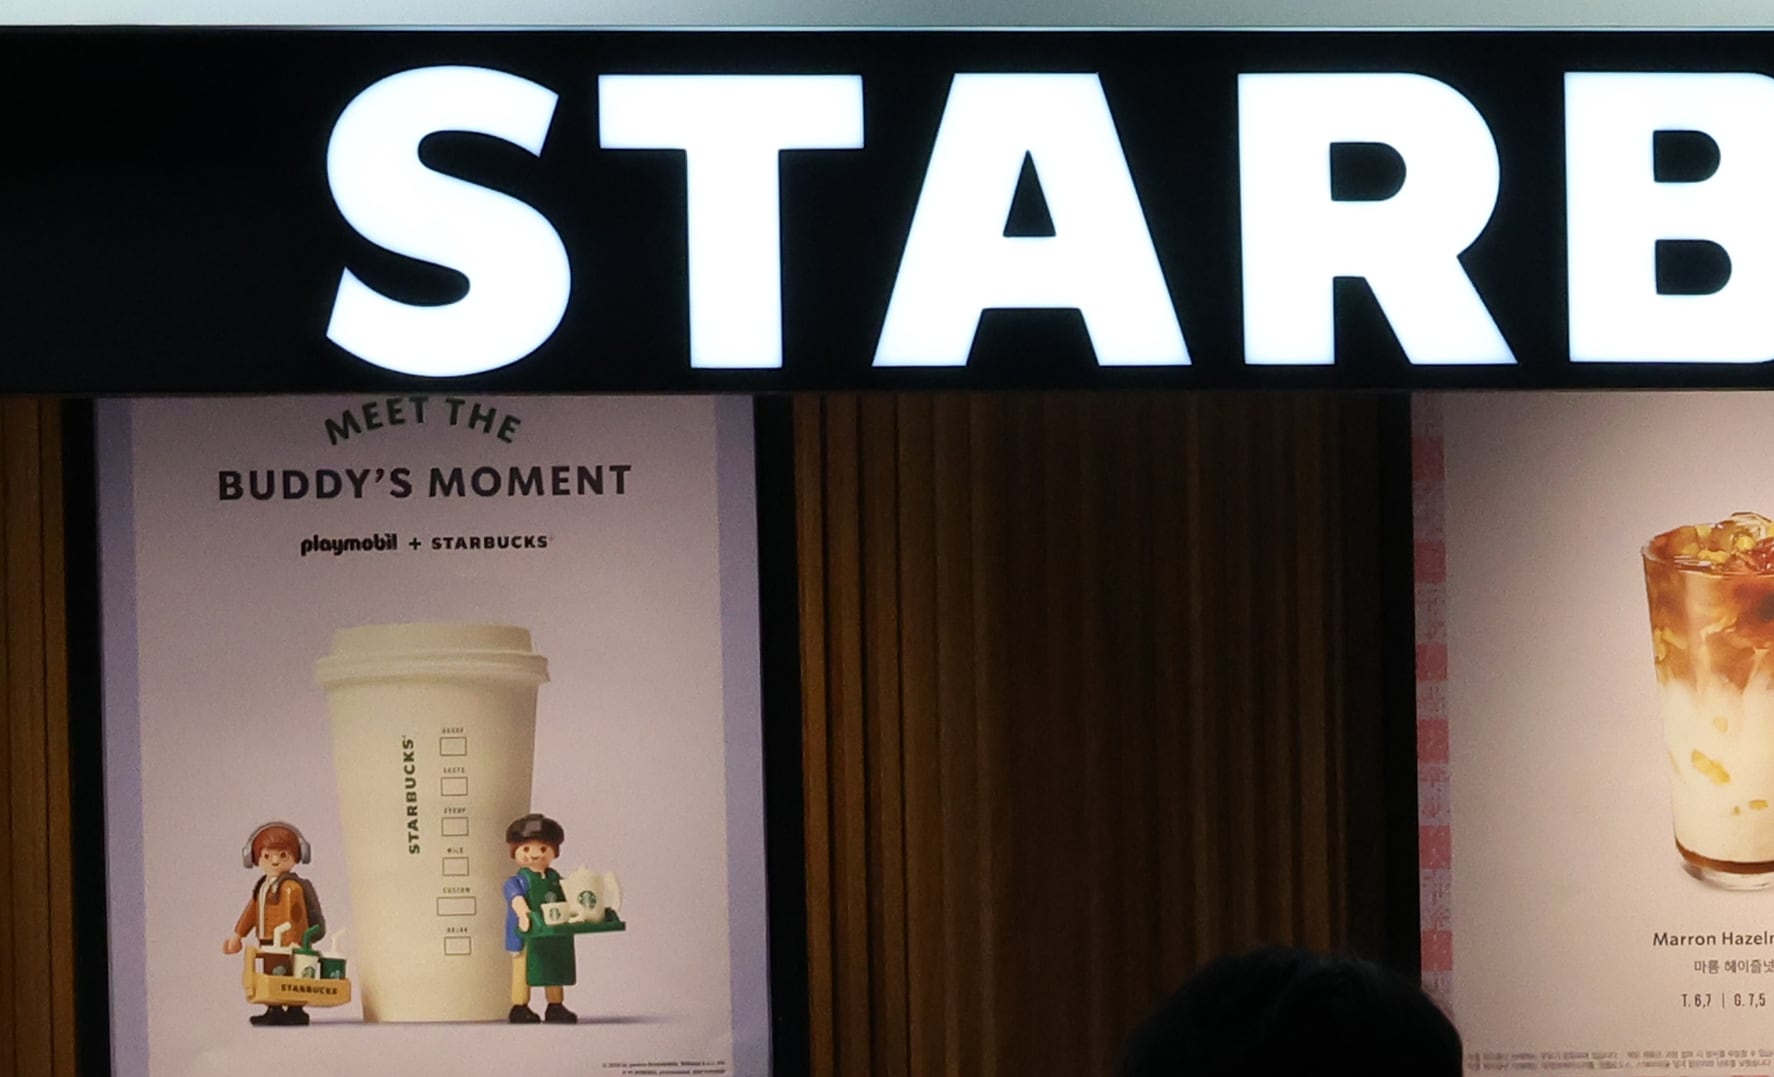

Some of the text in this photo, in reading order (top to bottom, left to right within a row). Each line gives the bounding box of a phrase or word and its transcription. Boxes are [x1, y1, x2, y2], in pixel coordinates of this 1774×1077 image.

[325, 396, 521, 445] MEET THE
[218, 464, 632, 500] BUDDY'S MOMENT
[300, 533, 398, 556] playmobil
[431, 535, 549, 551] STARBUCKS
[402, 738, 421, 855] STARBUCKS
[1653, 932, 1716, 946] Marron
[1694, 960, 1719, 974] 마롱
[1724, 959, 1774, 974] 헤이즐넛
